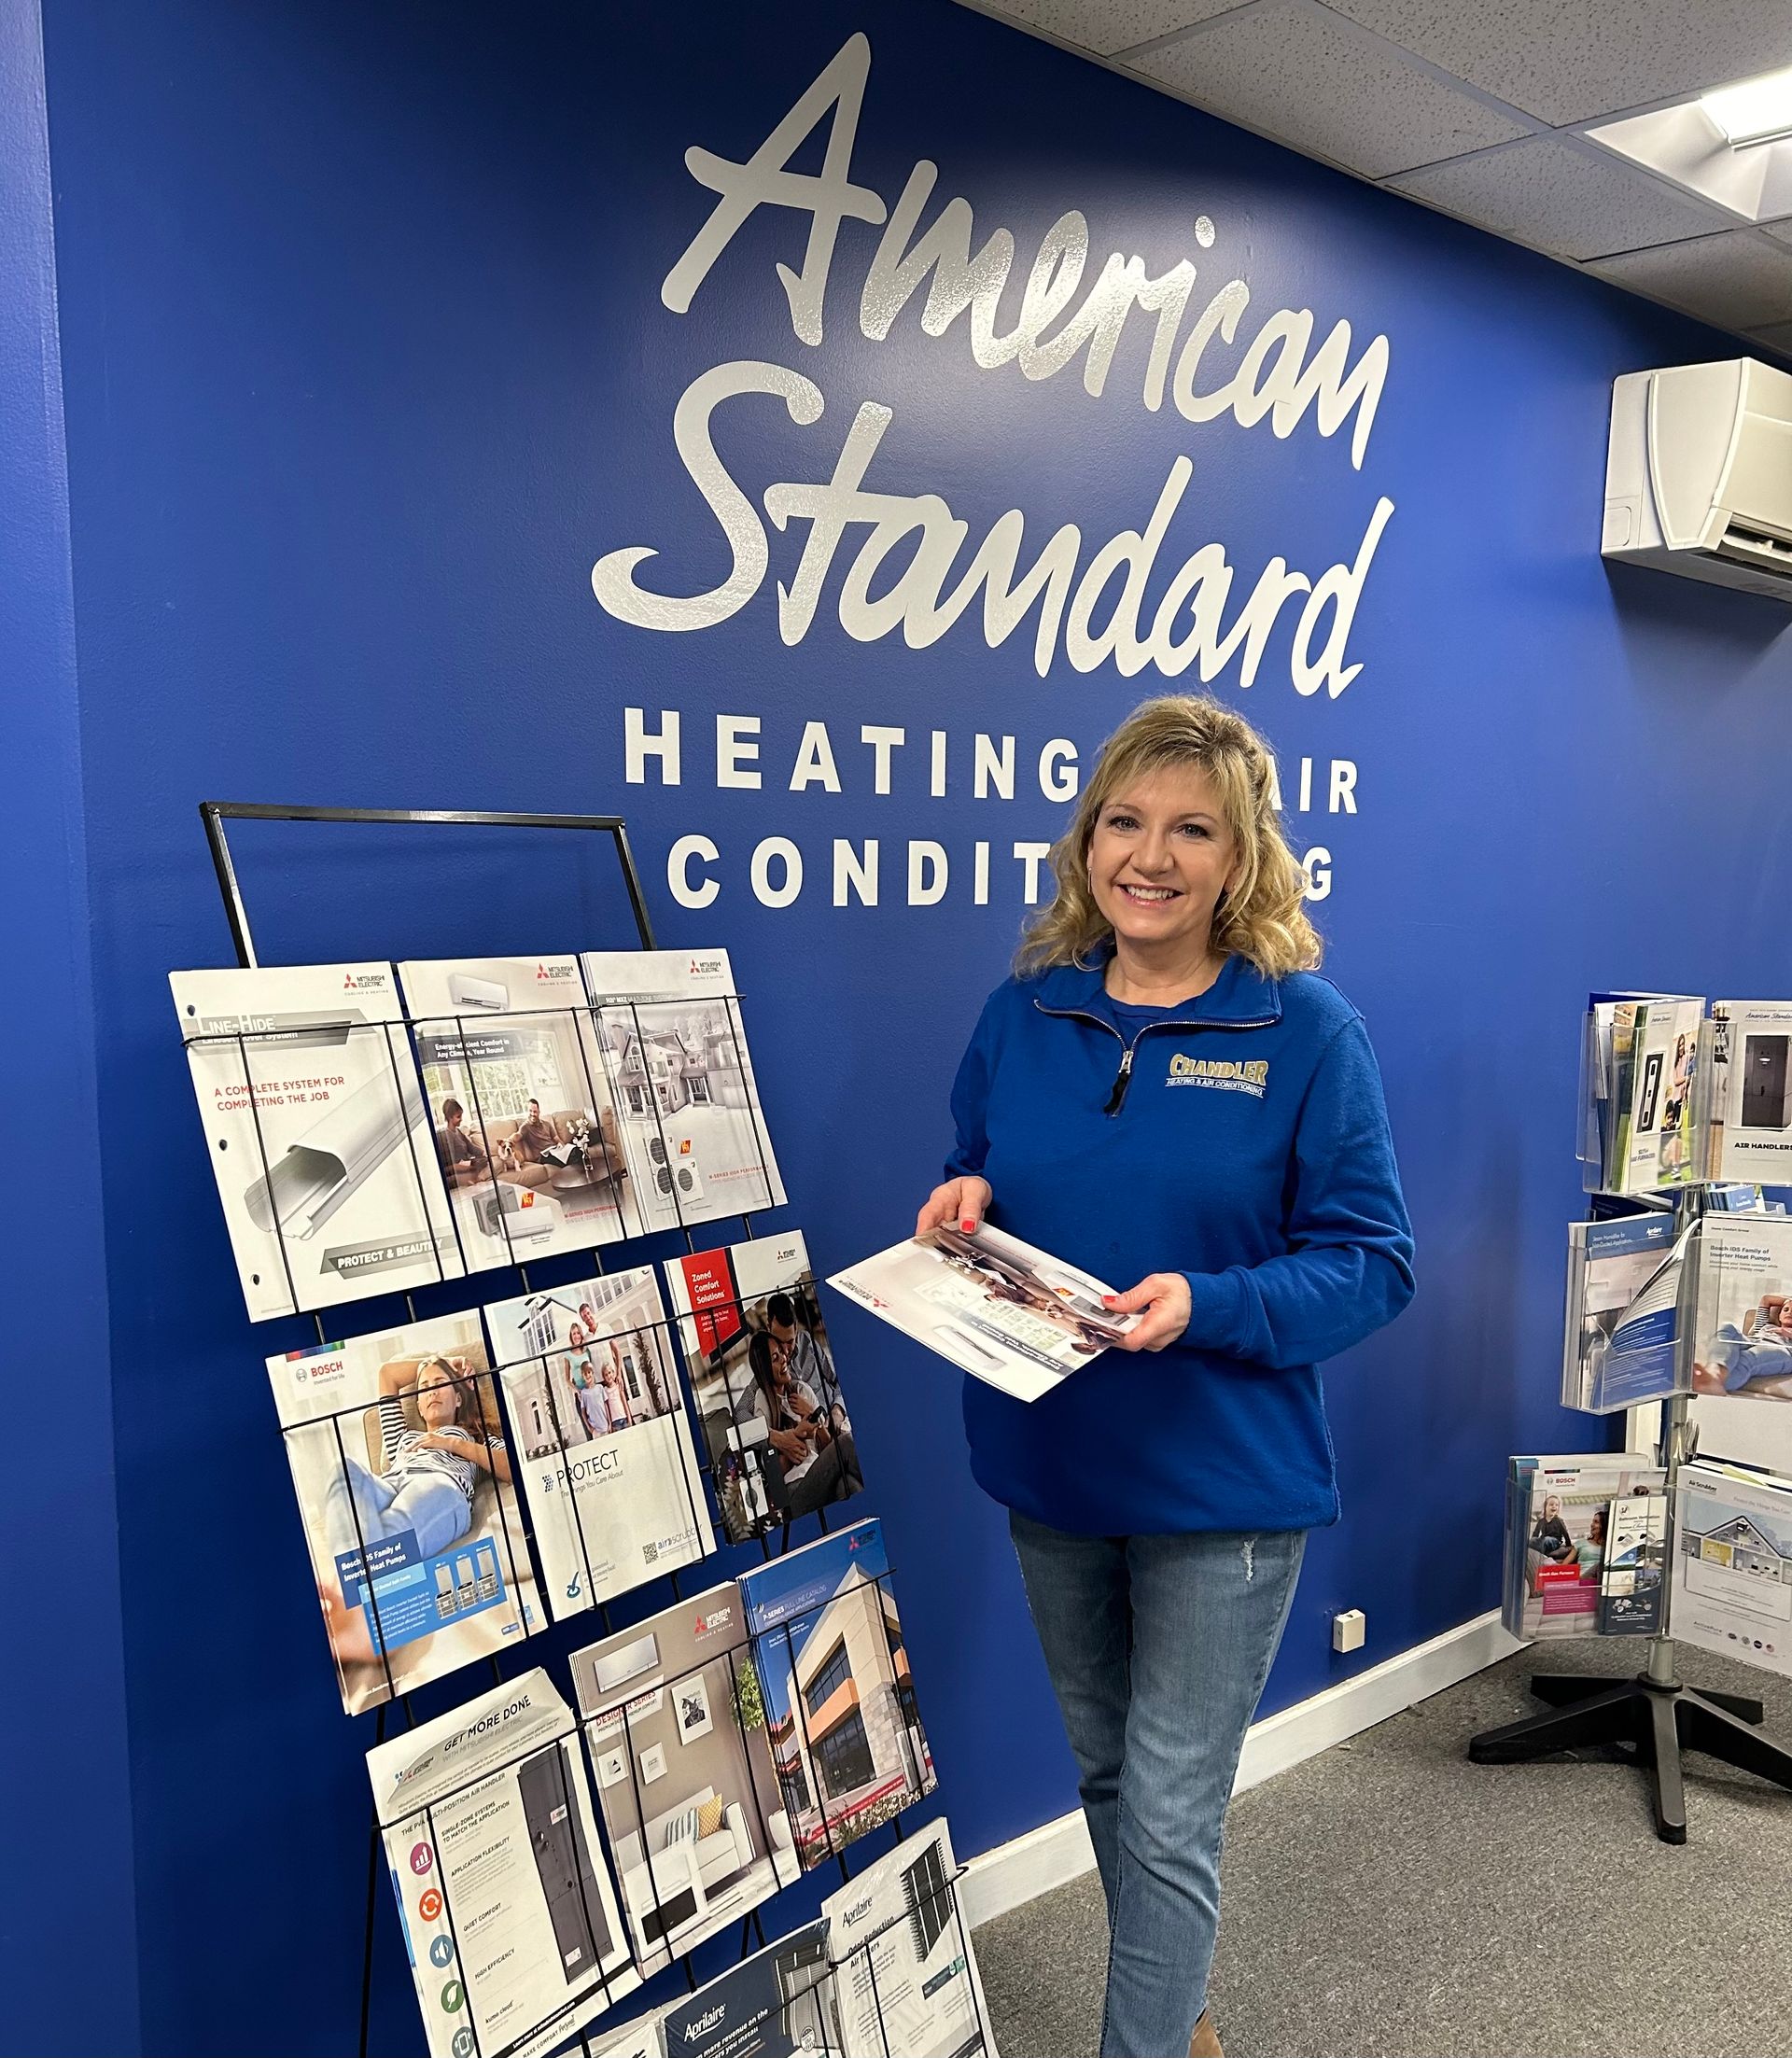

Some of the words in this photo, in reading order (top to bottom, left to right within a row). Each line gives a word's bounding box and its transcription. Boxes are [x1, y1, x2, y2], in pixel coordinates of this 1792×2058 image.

[661, 32, 1389, 469] American
[591, 361, 1394, 698] Standard
[624, 707, 1079, 803] HEATING
[667, 835, 1332, 908] CONDITG
[242, 1033, 263, 1042] over
[435, 1042, 480, 1050] Energy-efcient
[1169, 1054, 1269, 1085] CHANDLER
[215, 1088, 222, 1098] A
[225, 1083, 280, 1096] COMPLETE
[283, 1079, 322, 1090] SYSTEM
[325, 1077, 344, 1085] FOR
[217, 1095, 284, 1112] COMPLETING
[287, 1093, 307, 1104] THE
[310, 1091, 329, 1102] JOB
[1215, 1081, 1263, 1096] CONDITIONING
[337, 1251, 384, 1268] PROTECT
[387, 1249, 394, 1258] &
[397, 1239, 442, 1257] BEAUTIY
[692, 1270, 711, 1282] Zoned
[694, 1281, 720, 1293] Comfort
[310, 1360, 343, 1377] BOSCH
[556, 1449, 619, 1488] PROTECT
[595, 1477, 607, 1485] Care
[608, 1470, 623, 1480] About
[671, 1524, 702, 1544] scrubbr
[341, 1559, 361, 1571] Bosch
[374, 1547, 394, 1561] Family
[395, 1543, 401, 1551] of
[343, 1569, 371, 1582] Inverte
[371, 1561, 385, 1573] Heat
[385, 1554, 406, 1566] Pumps
[762, 1605, 785, 1620] P-SERIES
[444, 1734, 467, 1752] GET
[468, 1713, 500, 1739] MORE
[503, 1695, 531, 1720] DONE
[596, 1703, 632, 1727] DESIGNR
[401, 1826, 413, 1837] THE
[414, 1818, 426, 1829] PVA
[430, 1793, 470, 1820] ULTI-POSITION
[470, 1786, 481, 1798] AIR
[481, 1773, 506, 1792] HANDLER
[441, 1812, 473, 1836] SINGLE-ZONE
[474, 1800, 496, 1818] SYSTEMS
[442, 1835, 450, 1843] TO
[451, 1826, 468, 1840] MATCH
[469, 1820, 478, 1830] THE
[479, 1800, 510, 1824] APPLICATION
[451, 1853, 482, 1878] APPLICATION
[482, 1836, 510, 1857] FLEXIBILITY
[478, 1902, 501, 1922] COMFORT
[842, 1896, 873, 1928] Aprilaire
[850, 1953, 860, 1969] Air
[861, 1941, 879, 1959] Fiers
[684, 2004, 725, 2042] Aprilaire
[704, 2039, 721, 2056] more
[721, 2023, 747, 2044] revenue
[757, 2009, 768, 2020] the
[726, 2041, 737, 2053] you
